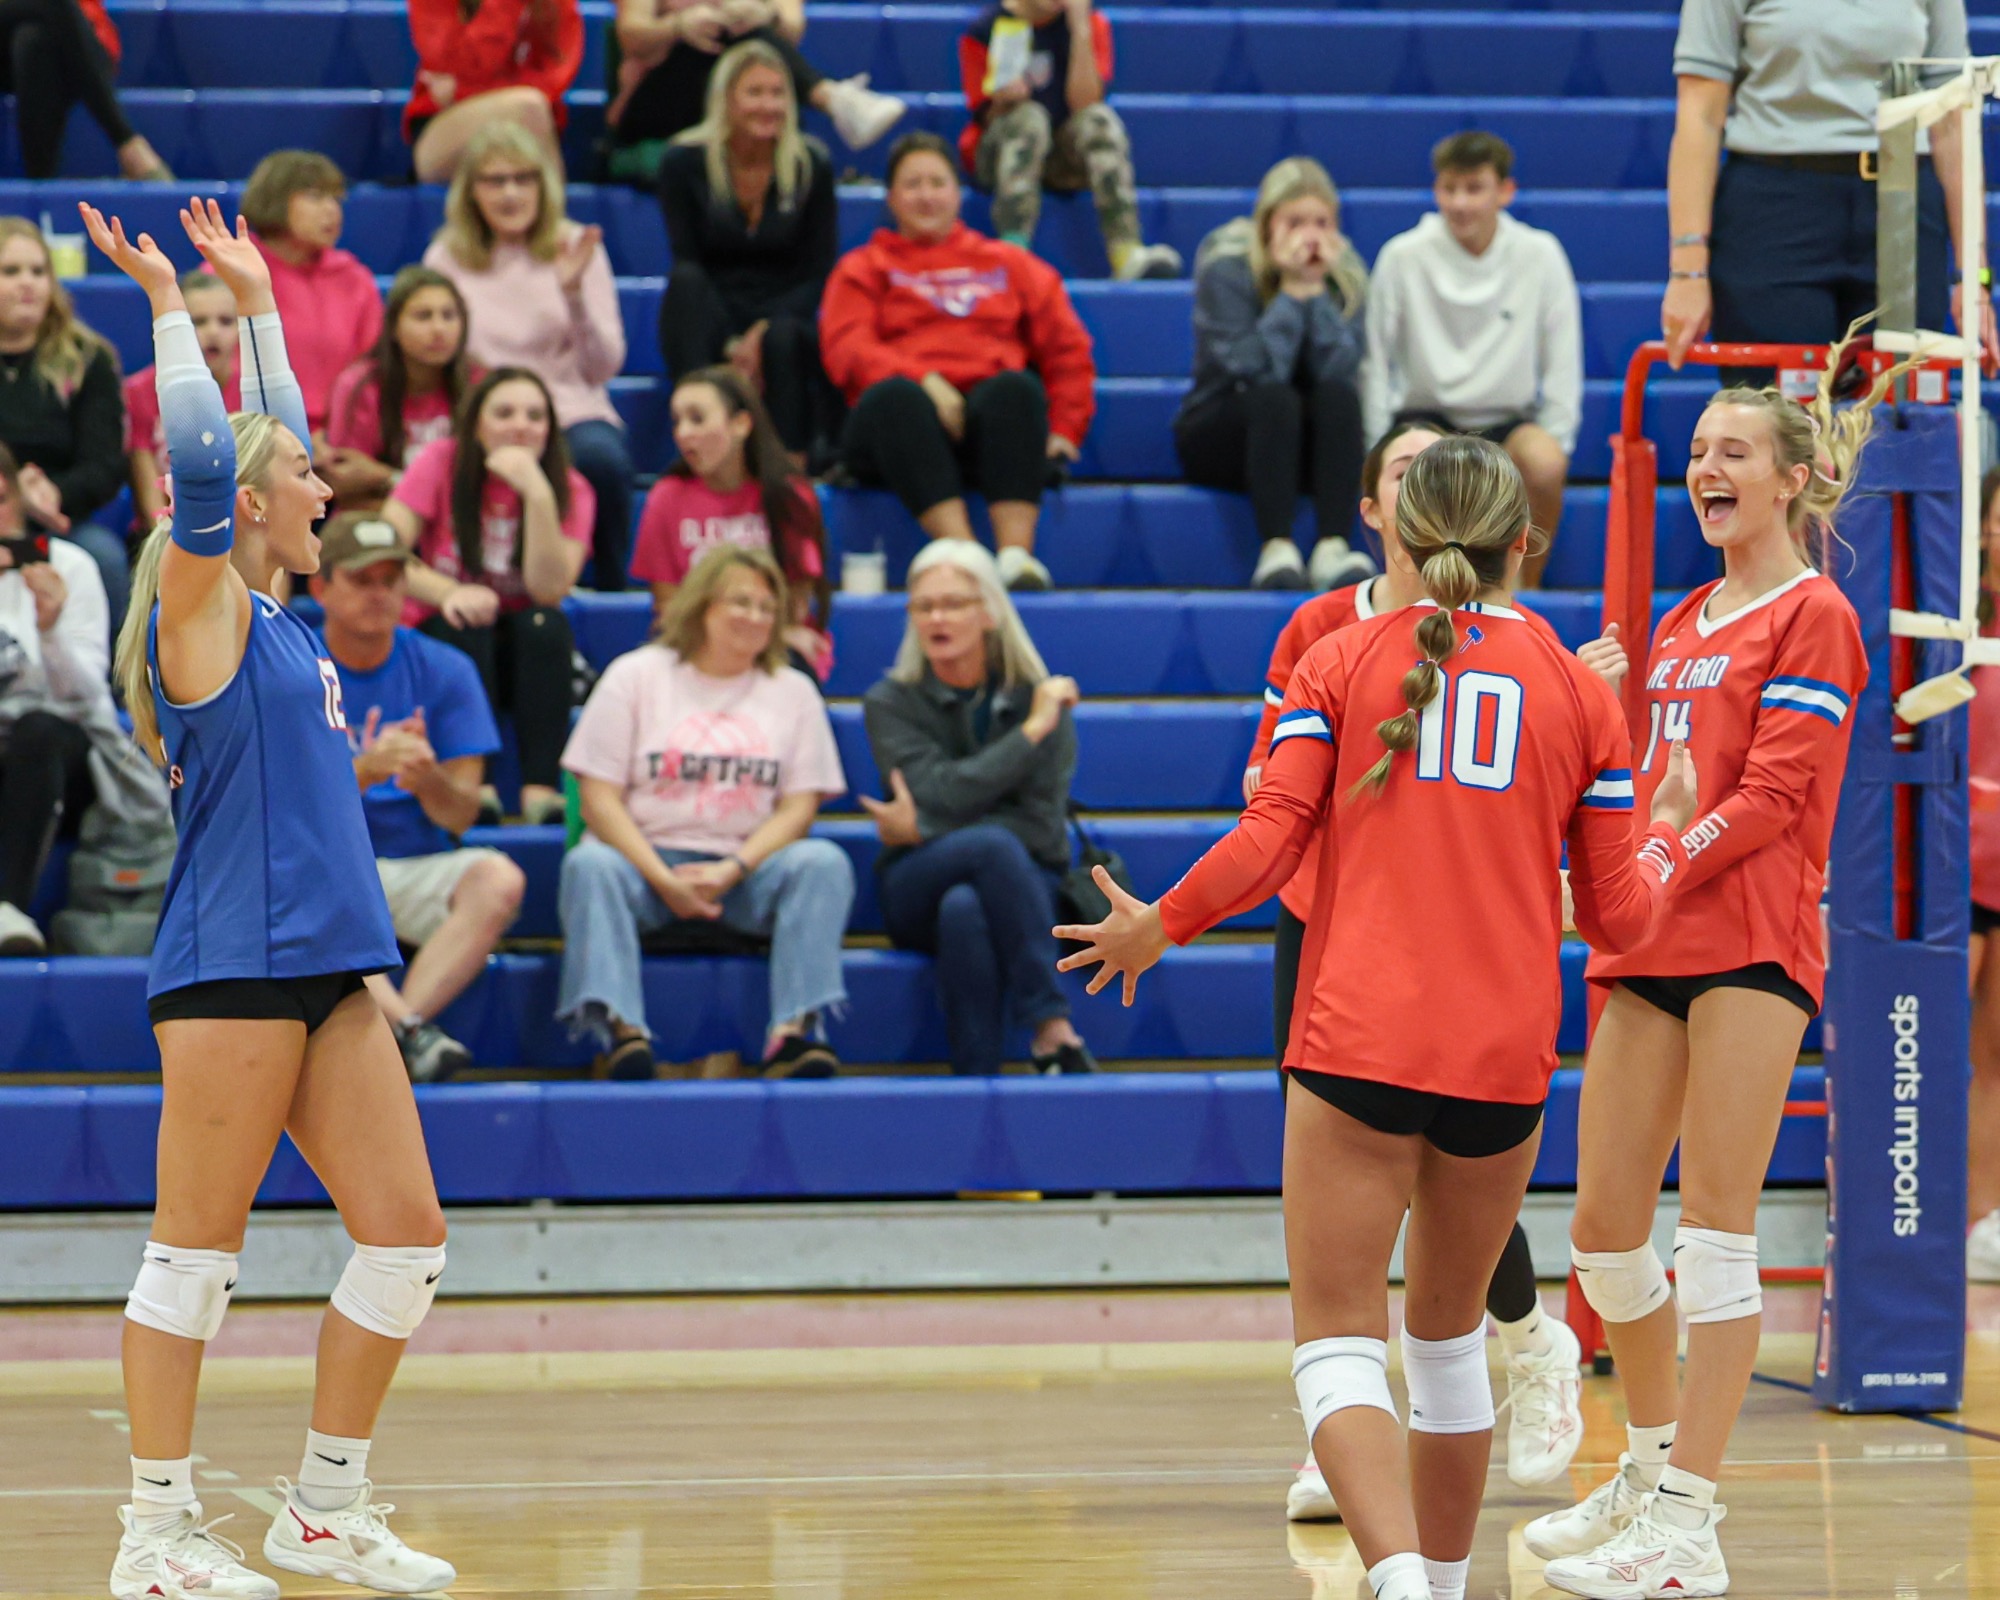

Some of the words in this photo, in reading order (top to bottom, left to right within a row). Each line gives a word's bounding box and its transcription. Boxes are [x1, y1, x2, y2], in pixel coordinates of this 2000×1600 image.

[1675, 654, 1731, 690] LAND
[1416, 660, 1524, 793] 10
[1640, 700, 1692, 773] 14
[1680, 812, 1729, 860] LOGG
[1888, 994, 1923, 1101] sports
